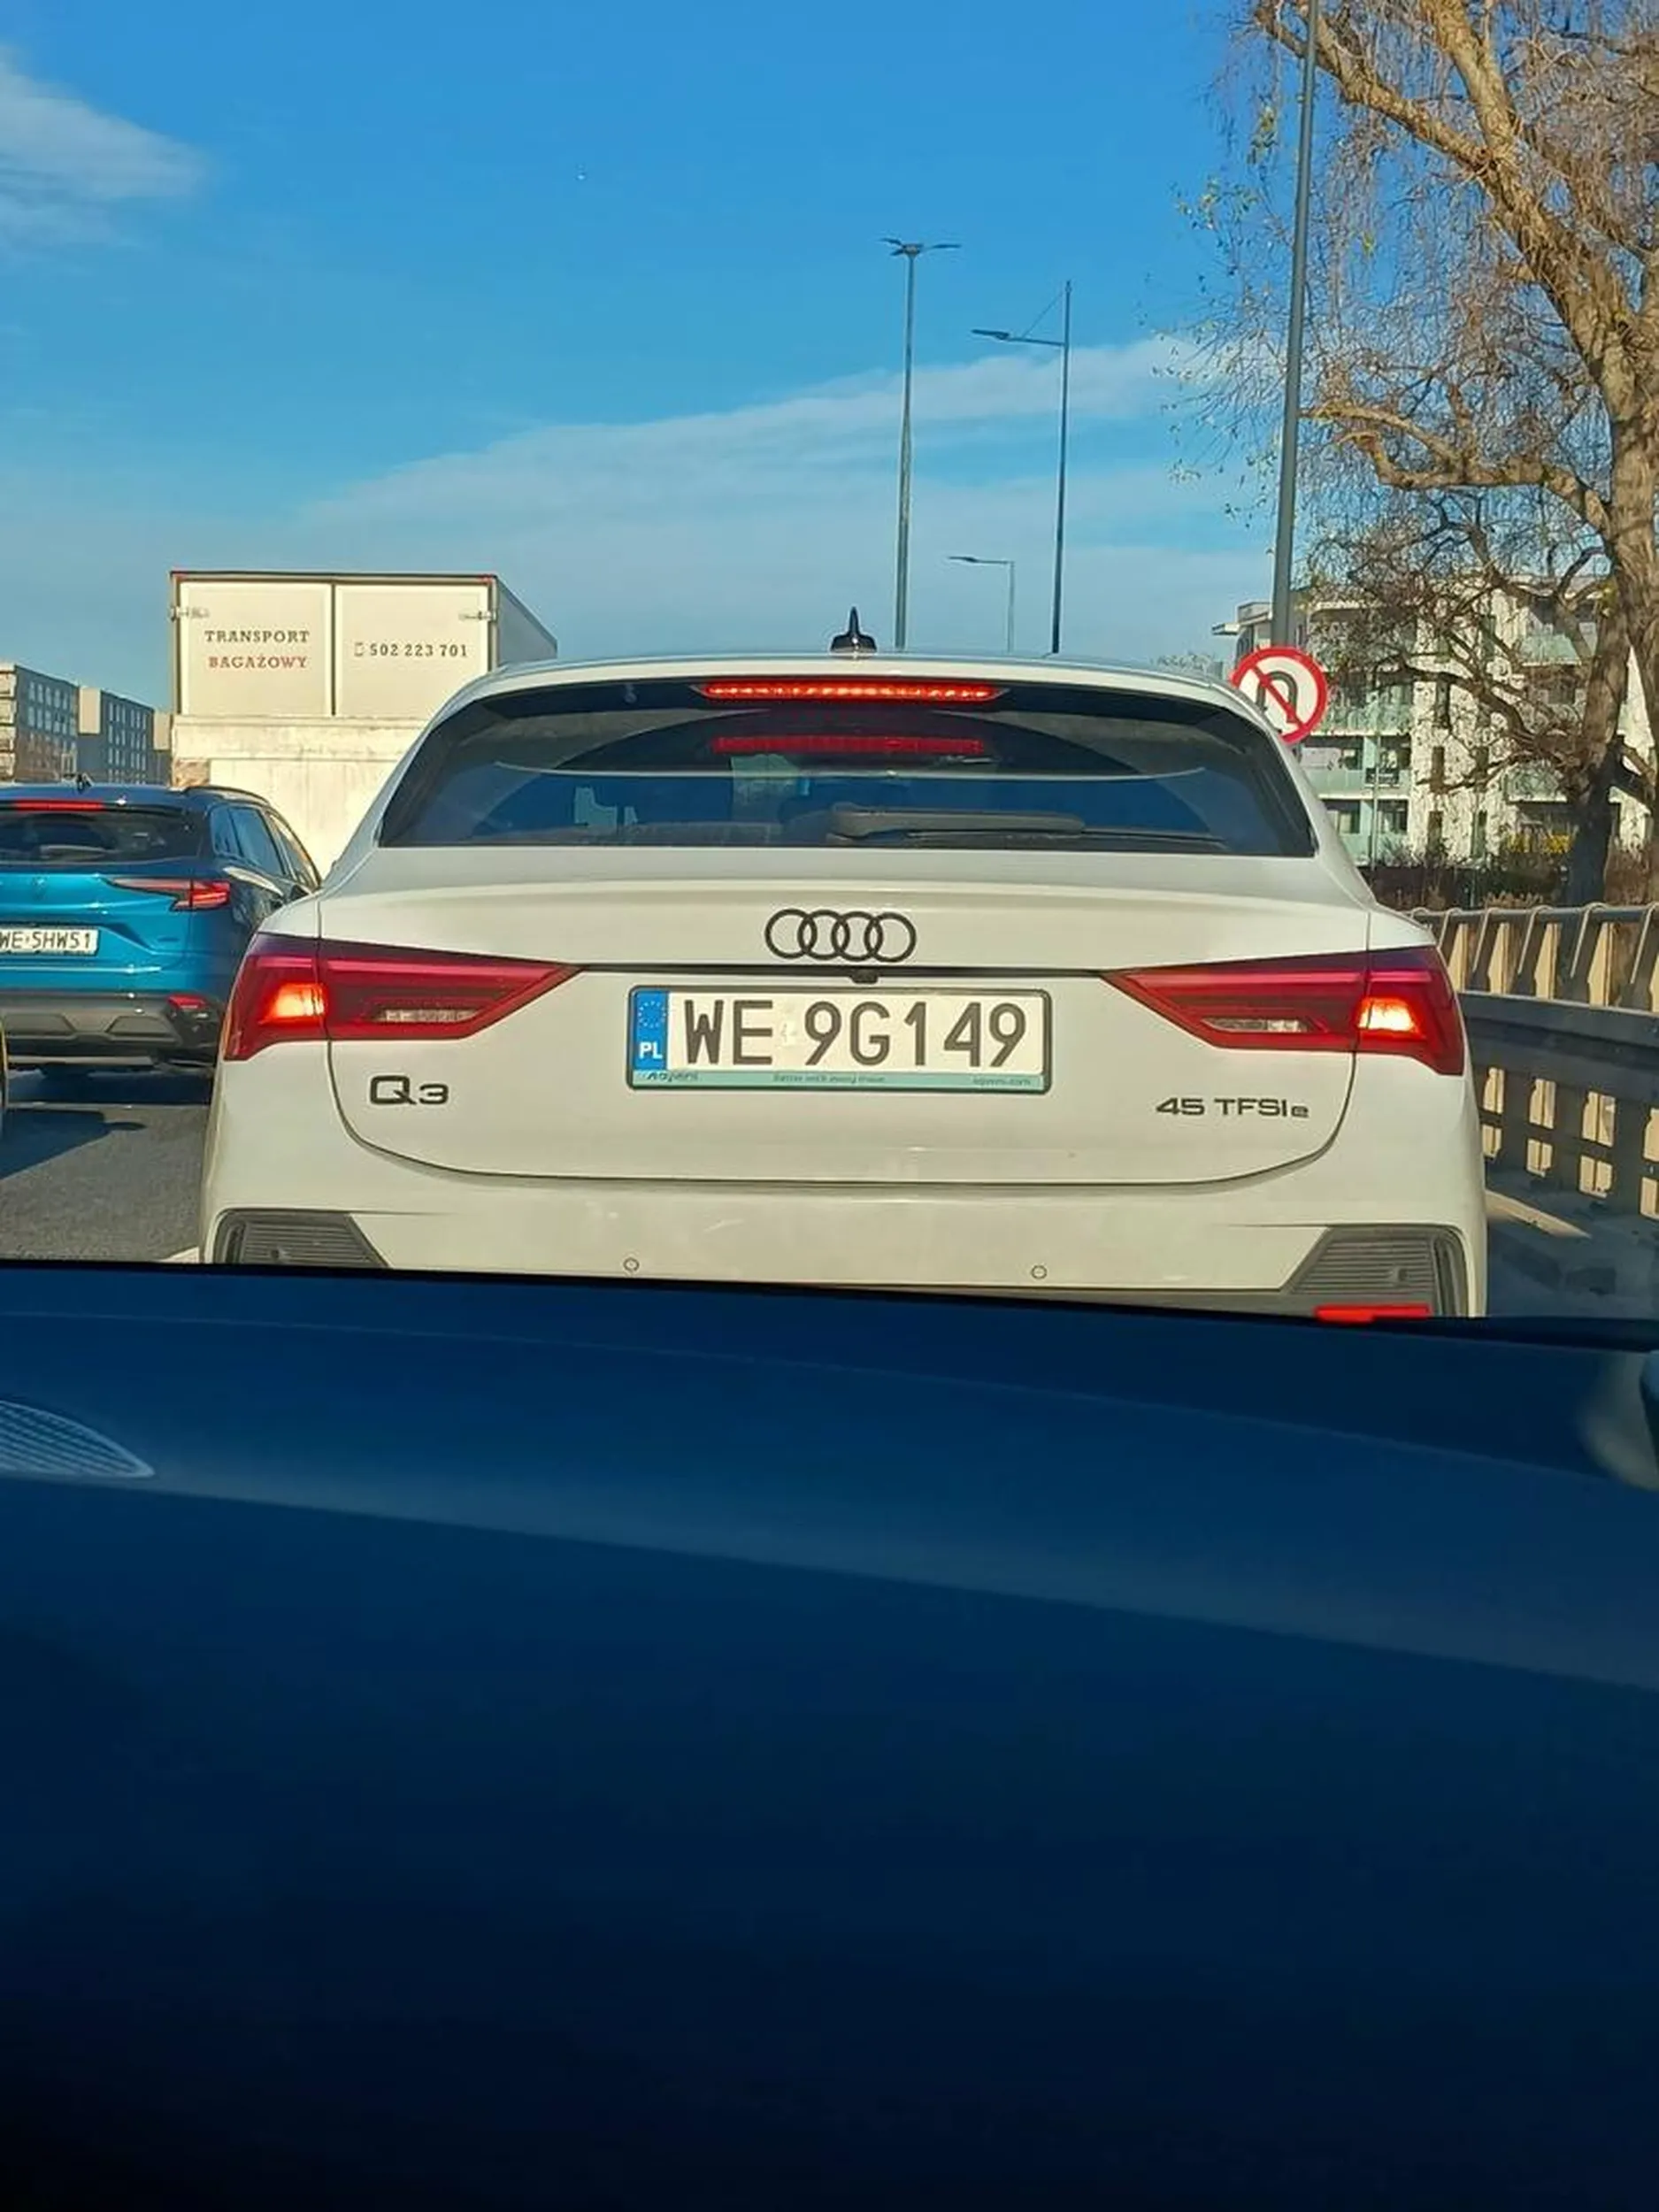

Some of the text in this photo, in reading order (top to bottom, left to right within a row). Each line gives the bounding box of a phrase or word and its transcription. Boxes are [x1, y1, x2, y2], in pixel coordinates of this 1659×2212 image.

[204, 630, 310, 643] TRANSPORT
[369, 642, 468, 657] 502 223 701
[208, 653, 307, 669] BAGAŻOWY
[0, 931, 23, 949] WE
[684, 999, 1026, 1068] WE 9G149
[640, 1041, 663, 1059] PL
[370, 1075, 449, 1105] Q3
[1156, 1097, 1205, 1116] 45
